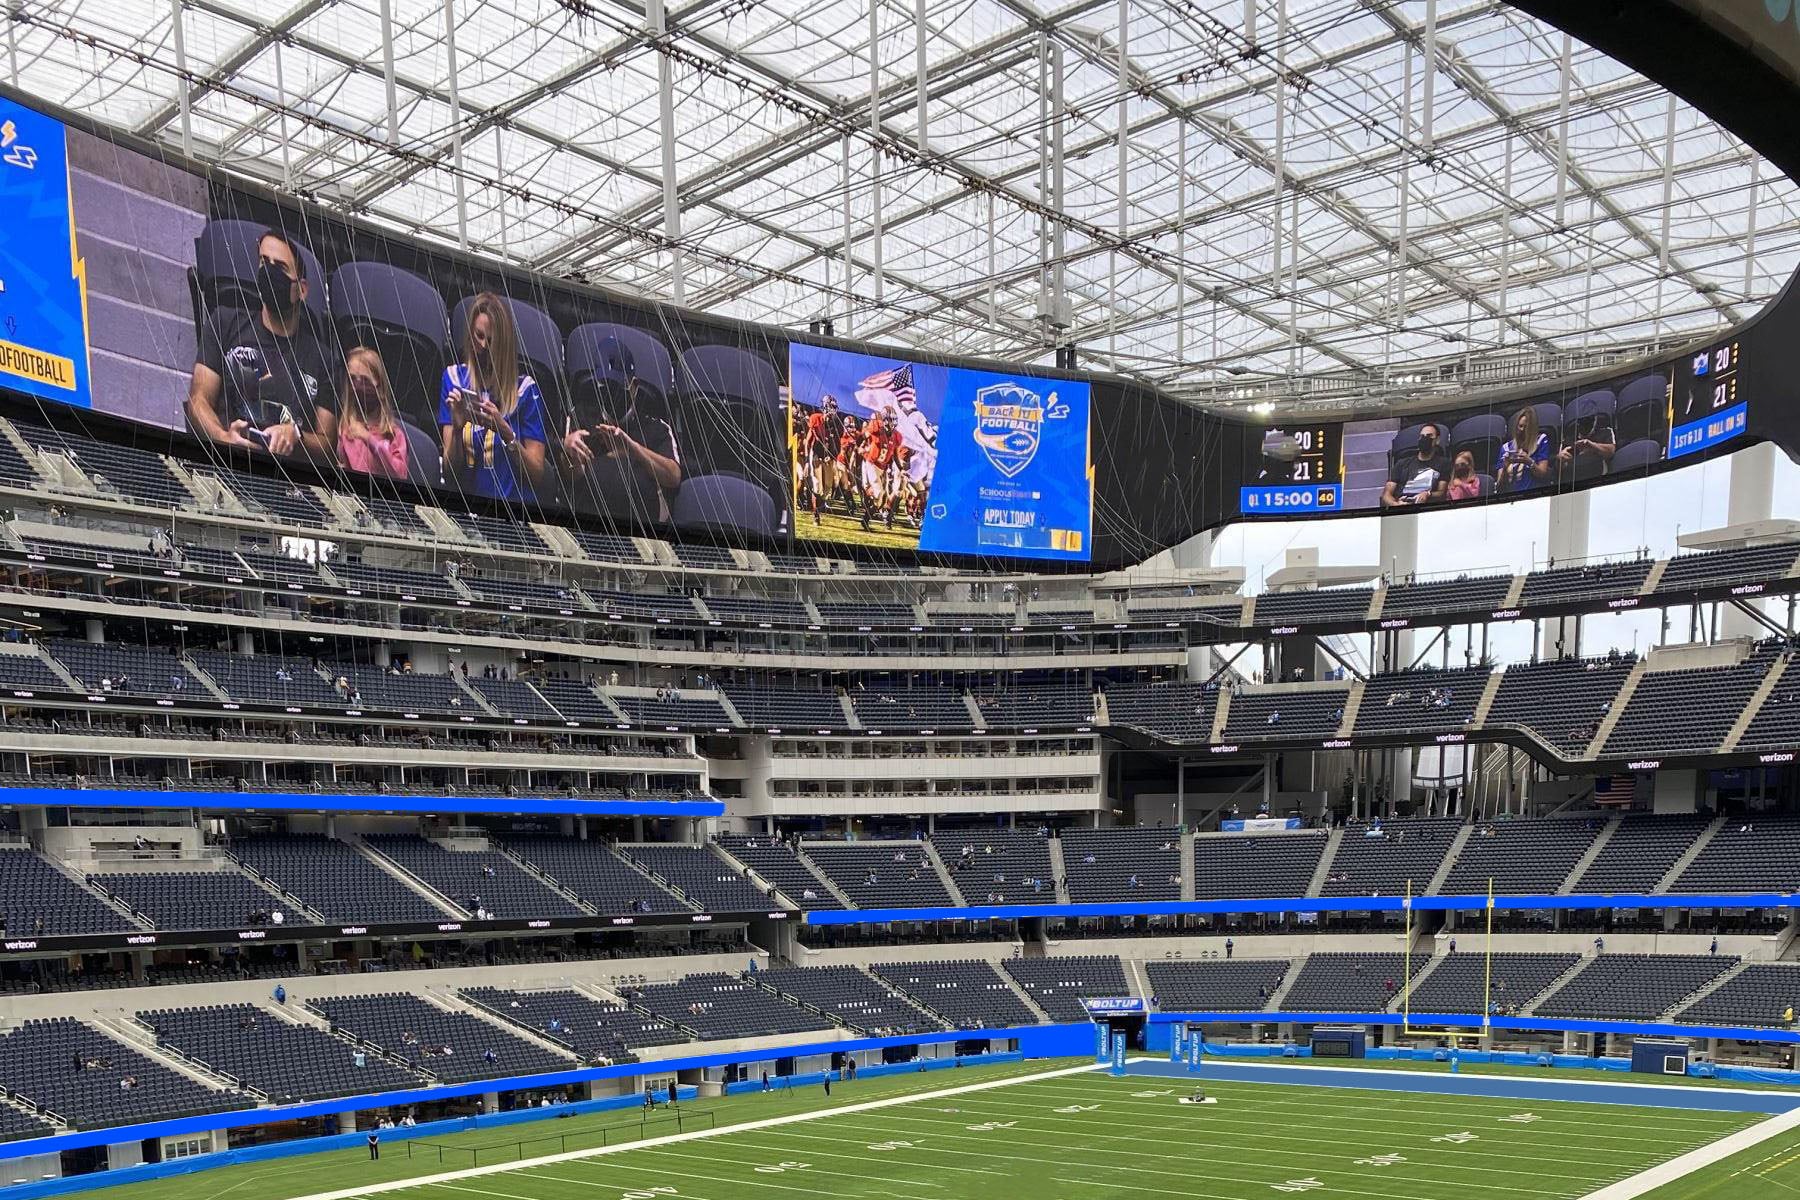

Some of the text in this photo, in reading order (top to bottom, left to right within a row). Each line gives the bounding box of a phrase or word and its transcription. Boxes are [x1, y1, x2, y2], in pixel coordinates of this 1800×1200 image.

[1715, 346, 1729, 372] 20
[1713, 383, 1727, 408] 21
[981, 418, 1037, 432] FOOTBALL
[1295, 431, 1311, 450] 20
[1294, 462, 1310, 480] 21
[1264, 491, 1313, 506] 15:00
[1319, 493, 1333, 502] 40
[985, 509, 1035, 526] APPLY TODAY
[1731, 584, 1765, 595] verizon
[1607, 598, 1639, 608] verizon
[1491, 609, 1521, 619] verizon
[1380, 619, 1408, 628] verizon
[1270, 626, 1298, 635] verizon
[1435, 733, 1465, 742] verizon
[1210, 744, 1238, 753] verizon
[1322, 739, 1351, 748] verizon
[1759, 752, 1794, 763] verizon
[1627, 760, 1660, 770] verizon
[692, 914, 712, 922] verizon
[768, 911, 787, 919] verizon
[528, 919, 551, 928] verizon
[612, 916, 634, 925] verizon
[341, 926, 367, 935] verizon
[437, 922, 462, 931] verizon
[126, 934, 156, 944] verizon
[238, 930, 266, 939] verizon
[4, 939, 37, 950] verizon
